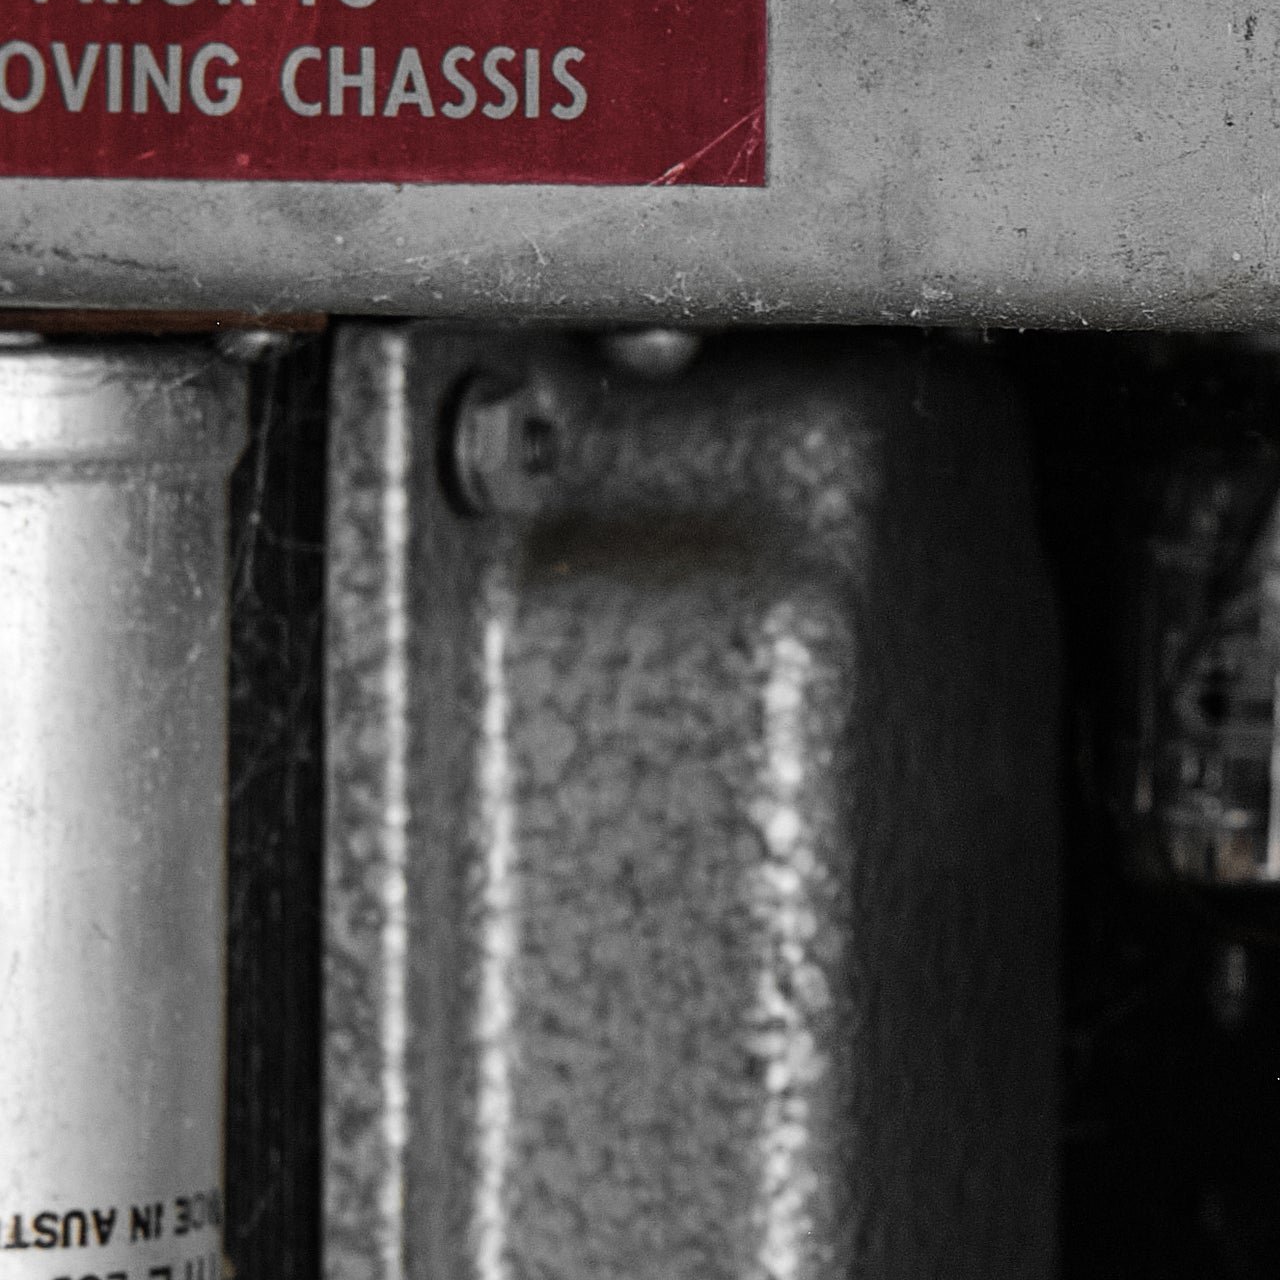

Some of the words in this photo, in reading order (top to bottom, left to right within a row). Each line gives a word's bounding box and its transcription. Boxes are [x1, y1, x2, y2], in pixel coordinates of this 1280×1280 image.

[280, 44, 589, 121] CHASSIS
[0, 1208, 117, 1251] AUST
[129, 1202, 164, 1244] IN
